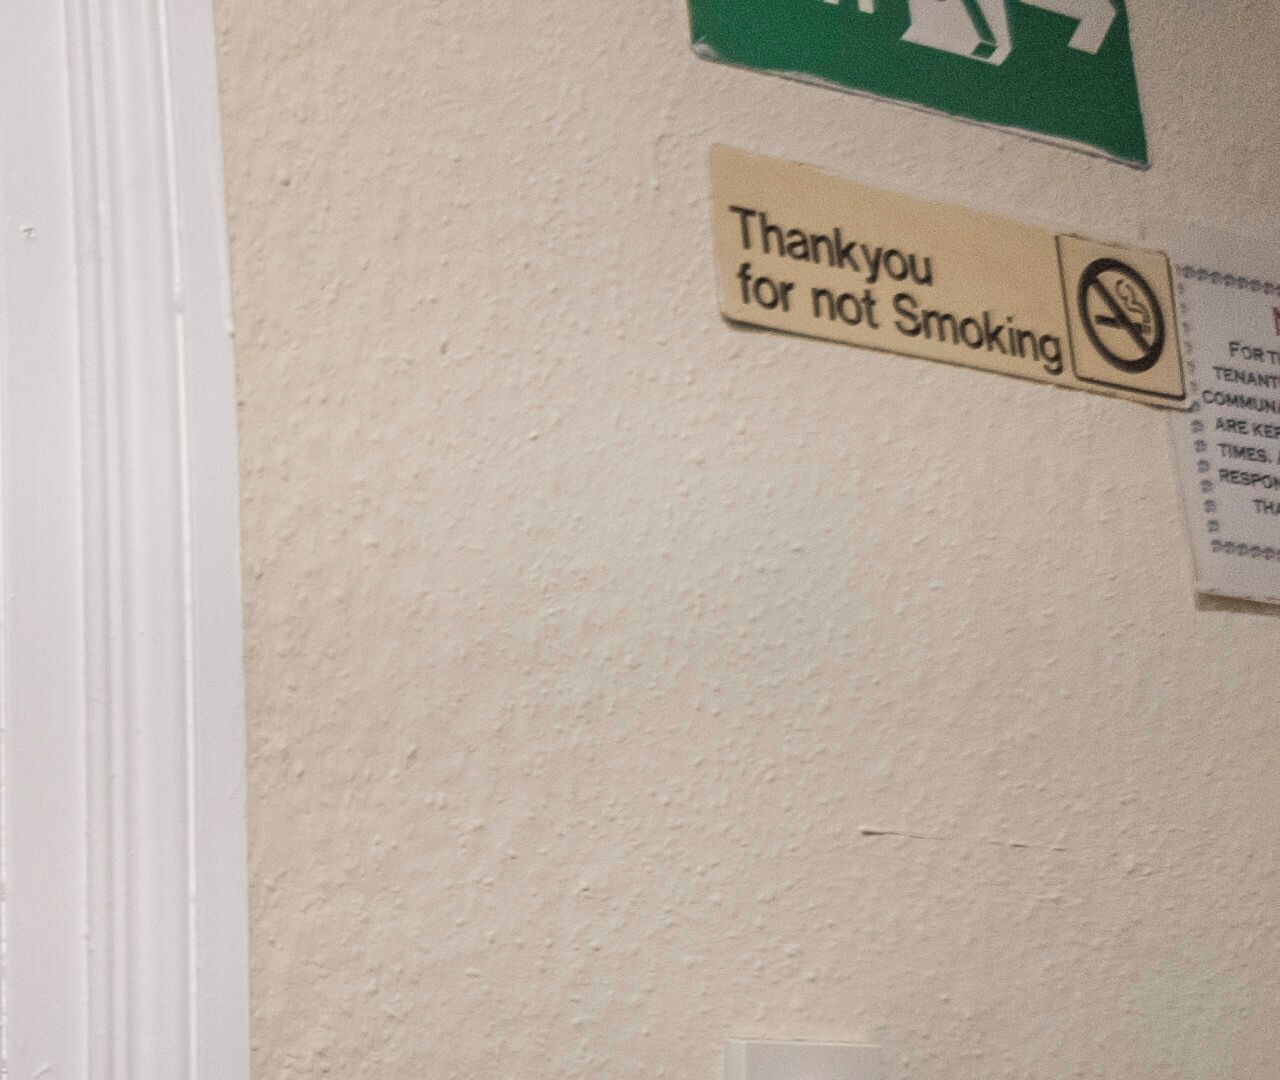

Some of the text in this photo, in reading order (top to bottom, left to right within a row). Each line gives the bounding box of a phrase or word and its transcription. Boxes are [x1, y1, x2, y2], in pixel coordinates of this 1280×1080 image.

[737, 262, 1064, 375] for not Smoking
[1229, 341, 1264, 362] FOR
[1216, 417, 1249, 434] ARE
